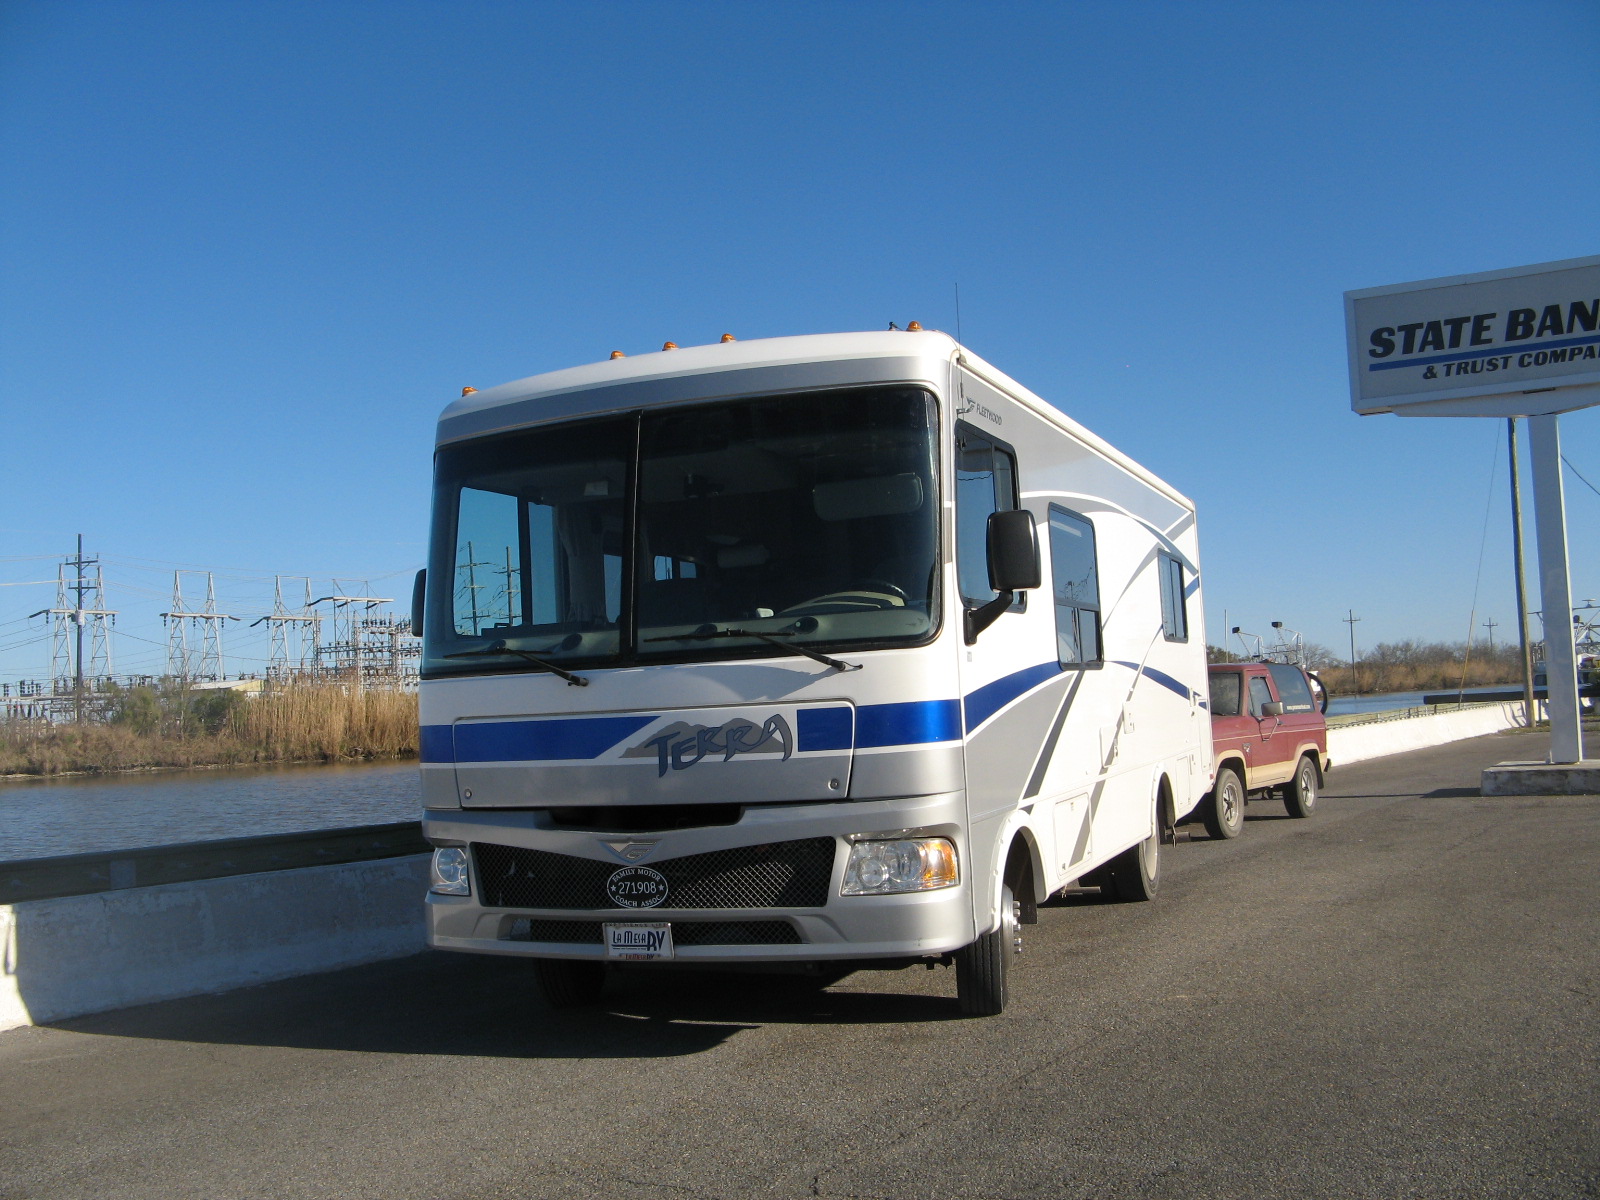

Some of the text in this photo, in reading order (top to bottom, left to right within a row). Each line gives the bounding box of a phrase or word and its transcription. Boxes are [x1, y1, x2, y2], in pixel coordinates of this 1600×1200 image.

[1368, 299, 1600, 359] STATE BAN
[1422, 345, 1600, 380] & TRUST COMPA
[644, 713, 794, 778] TERRA
[612, 868, 661, 882] FAMILY MOTOR
[618, 881, 657, 894] 271908
[615, 895, 638, 907] COACH
[646, 930, 666, 952] RV
